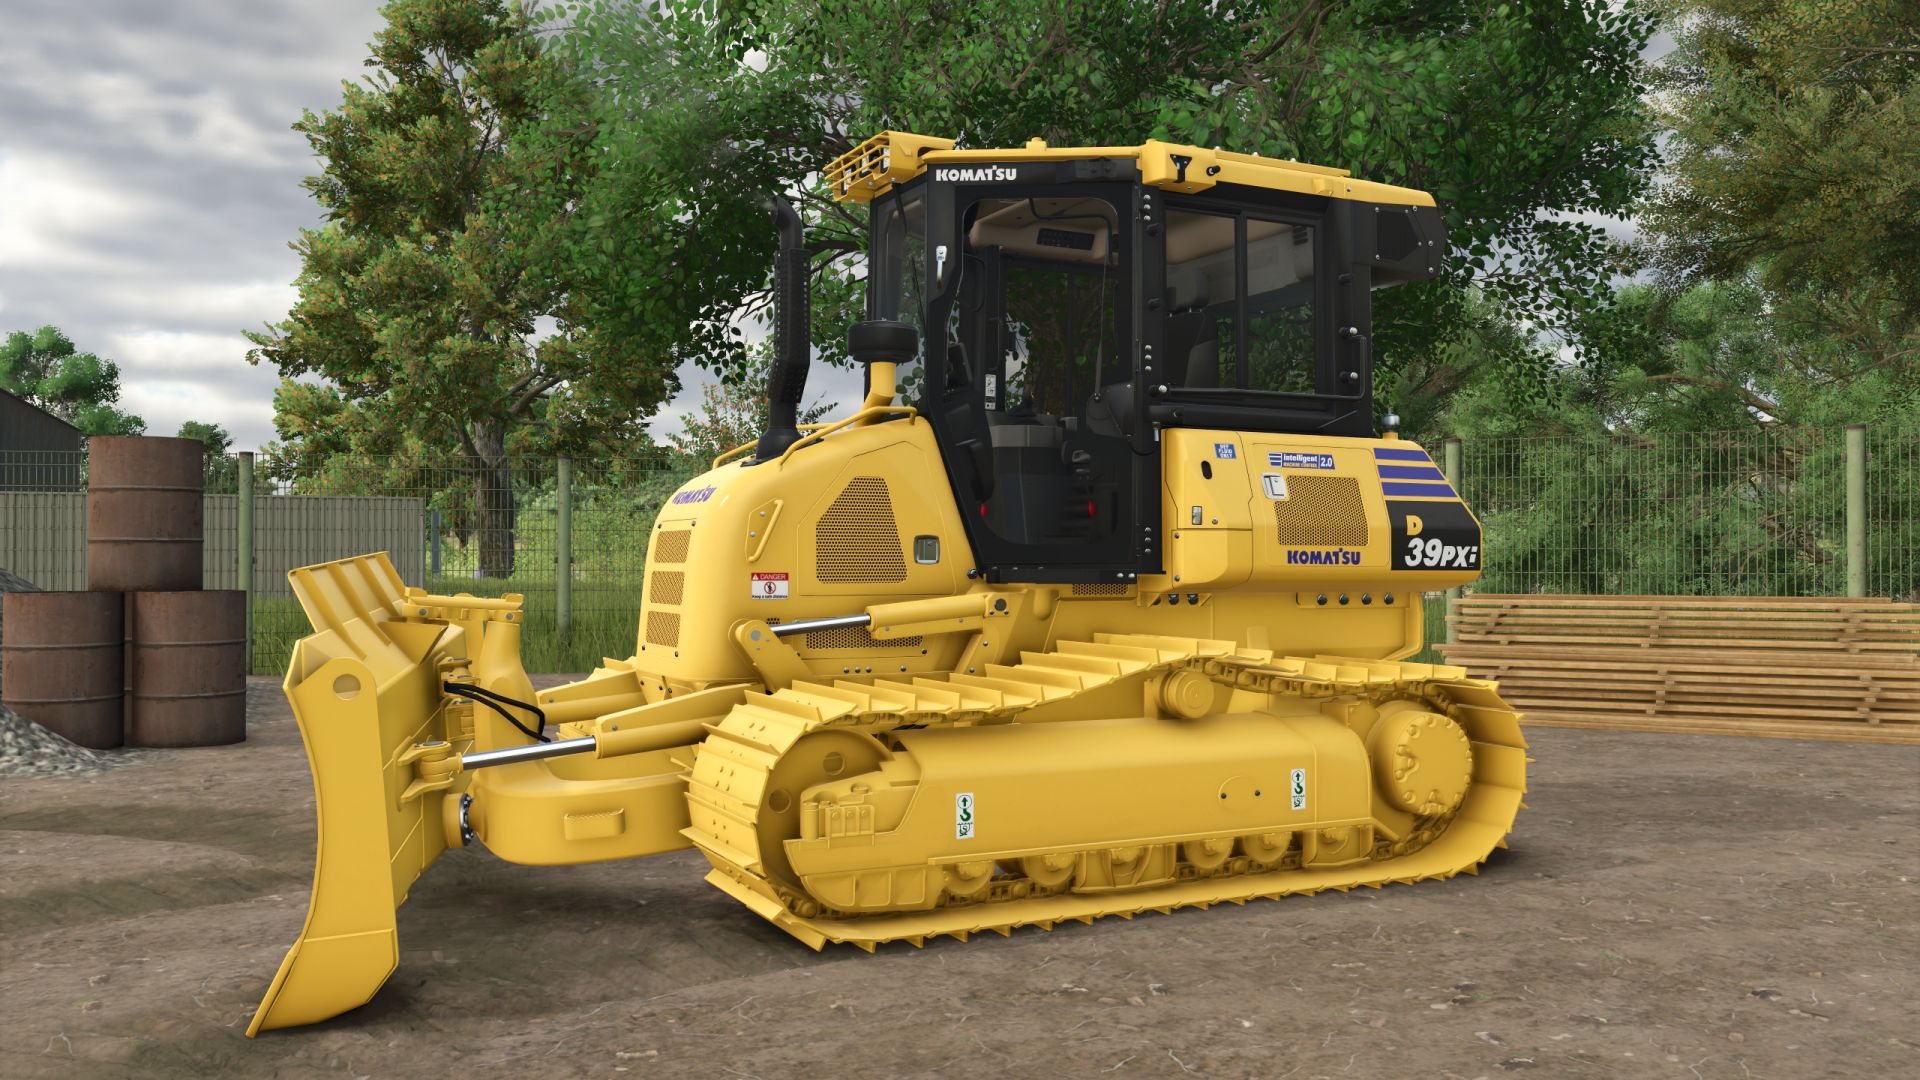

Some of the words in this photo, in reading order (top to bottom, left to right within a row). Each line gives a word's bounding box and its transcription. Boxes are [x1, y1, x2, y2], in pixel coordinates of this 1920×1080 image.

[936, 165, 1017, 181] KOMATSU
[1283, 453, 1318, 463] intelligent
[1320, 457, 1333, 467] 2.0
[1406, 515, 1423, 536] D
[1287, 547, 1361, 565] KOMATSU
